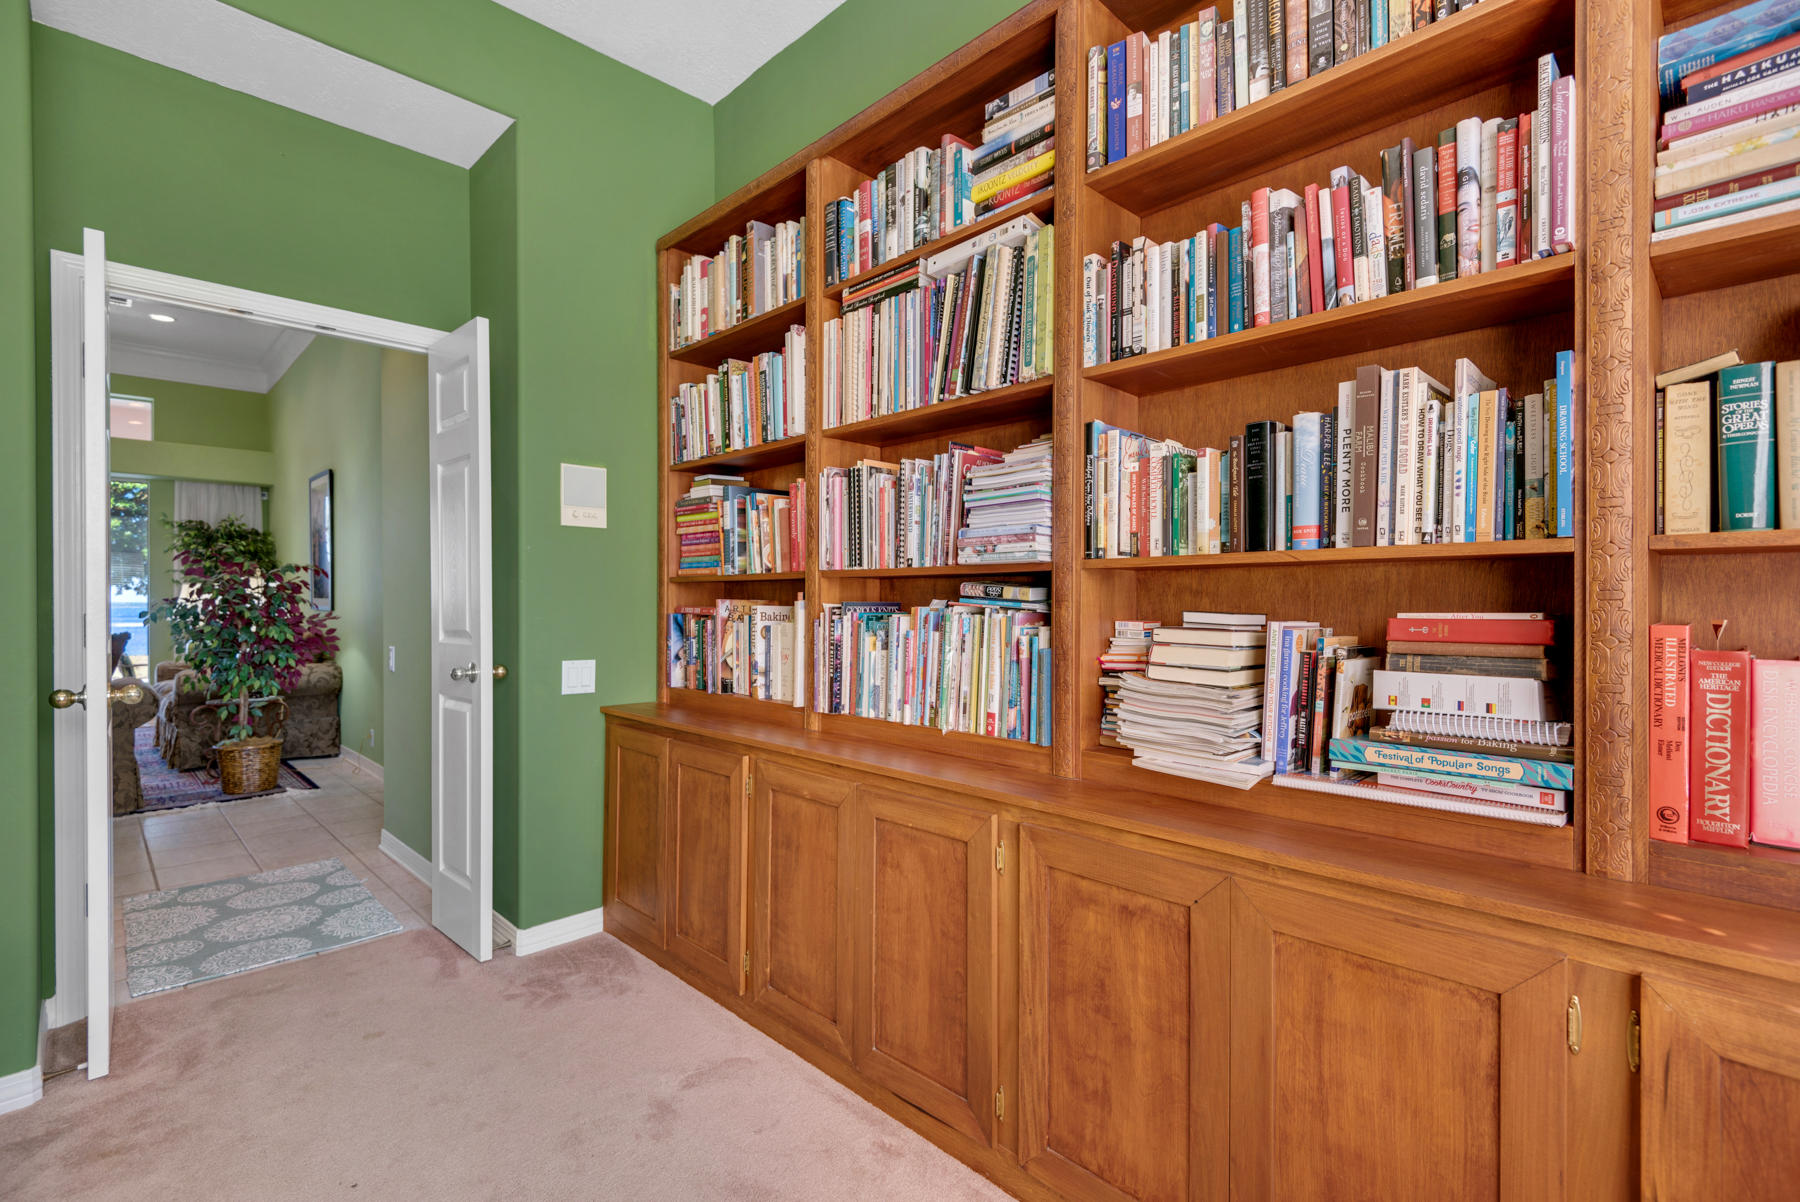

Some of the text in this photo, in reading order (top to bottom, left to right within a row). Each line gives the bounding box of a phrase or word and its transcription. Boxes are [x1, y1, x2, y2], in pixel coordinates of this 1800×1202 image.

[1703, 50, 1788, 90] THE HAIKU
[1553, 86, 1569, 135] Satisfaction
[1697, 98, 1732, 112] AUDEN
[988, 184, 1020, 205] KOONTZ
[1420, 166, 1429, 220] david sedaris
[1369, 232, 1384, 259] dads
[1721, 399, 1768, 414] STORIES
[1366, 426, 1374, 456] MALIBU
[1400, 423, 1409, 446] DRAW
[1418, 430, 1423, 439] TO
[1559, 405, 1567, 475] DRAWING SCHOOL
[1722, 421, 1768, 434] OPERAS
[1341, 429, 1351, 513] PLENTY MORE
[1399, 449, 1408, 475] SQUAD
[1653, 637, 1663, 729] MEDICAL DICTIONARY
[1665, 637, 1677, 707] ILLUSTRATED
[1281, 674, 1289, 702] cooking
[1424, 734, 1458, 743] passion
[1461, 737, 1474, 745] for
[1477, 739, 1518, 752] Baking
[1763, 707, 1778, 806] ENCYCLOPEDIA
[1374, 750, 1511, 777] Festival of Popular Songs
[1704, 693, 1732, 822] DICTIONARY
